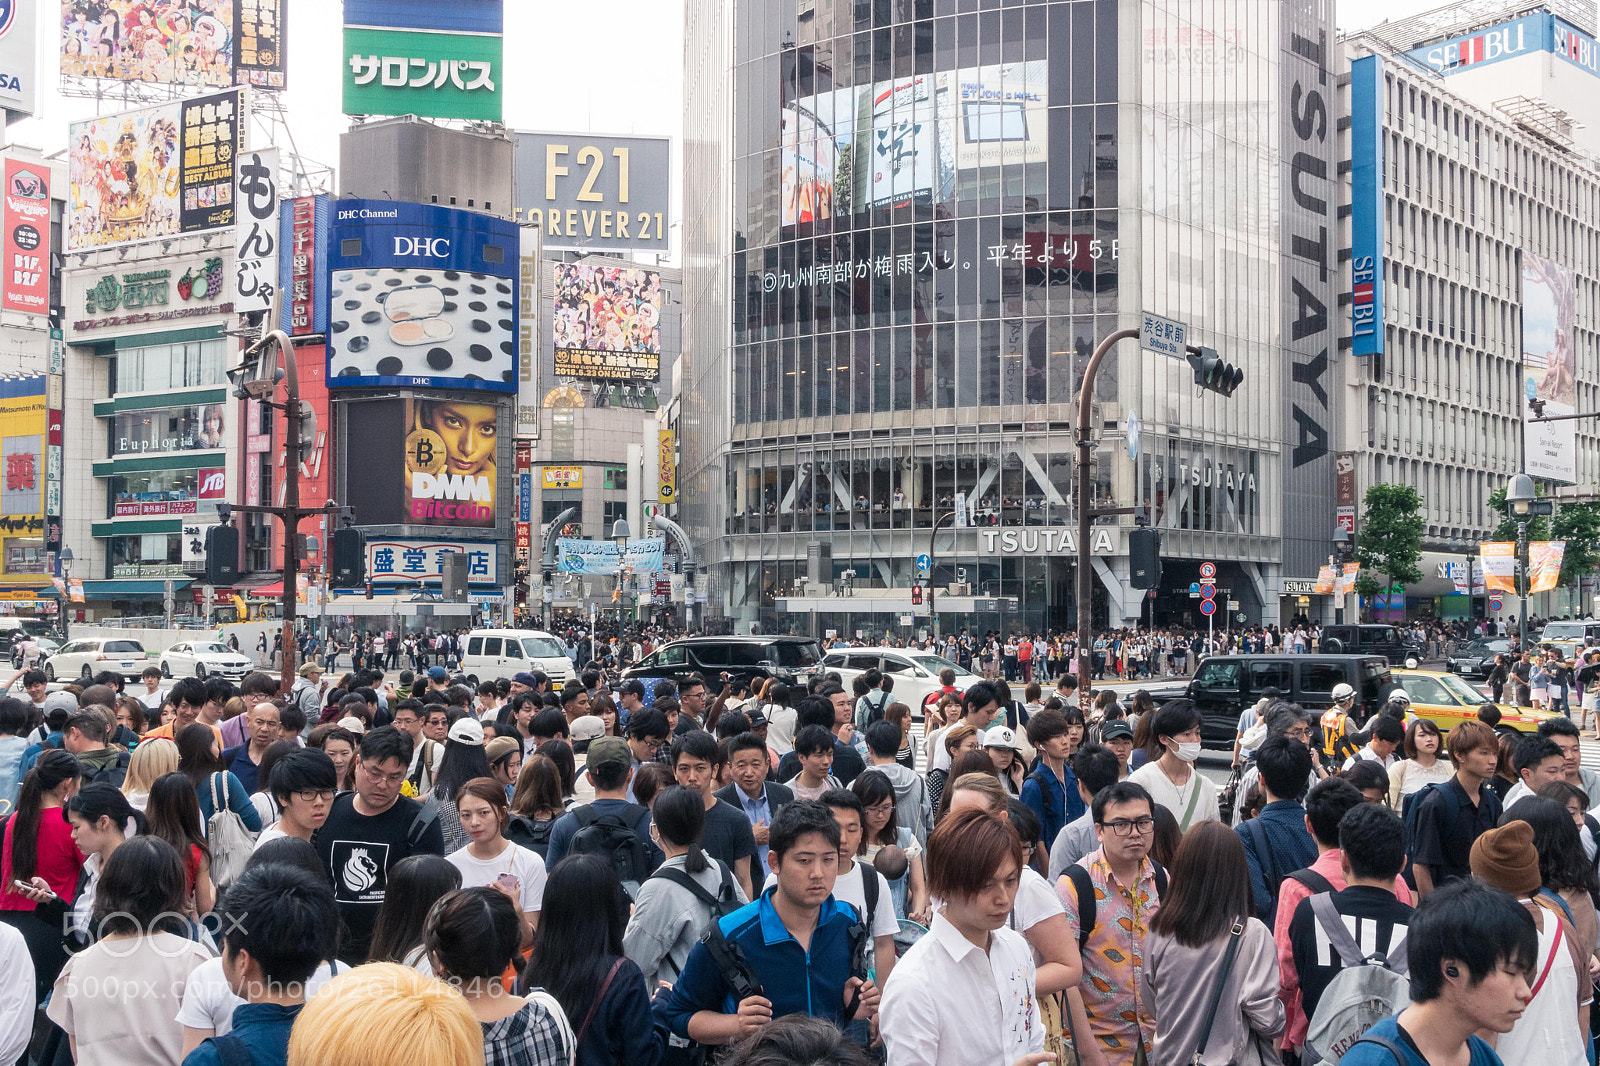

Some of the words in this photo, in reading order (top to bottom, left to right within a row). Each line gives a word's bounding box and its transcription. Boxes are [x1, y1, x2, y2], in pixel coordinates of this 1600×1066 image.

[1428, 24, 1526, 72] SEIBU
[1554, 24, 1597, 72] SEIBU
[350, 54, 495, 92] サロンパス
[185, 174, 202, 184] BEST
[204, 168, 232, 181] ALBUM
[546, 144, 629, 203] F21
[338, 210, 358, 220] DHC
[360, 209, 398, 219] Channel
[129, 224, 147, 239] ON
[238, 153, 276, 306] もんじゃ
[637, 212, 663, 240] 21
[393, 236, 450, 258] DHC
[1291, 28, 1328, 468] TSUTAYA
[14, 254, 40, 270] B1F
[14, 270, 41, 287] B2F
[520, 250, 536, 320] Taisei
[1353, 255, 1374, 338] SEIBU
[1144, 317, 1184, 344] 渋谷駅前
[519, 325, 532, 382] neon
[1150, 337, 1168, 350] Shibuya
[1169, 342, 1179, 353] Sta.
[412, 377, 430, 385] DHC
[555, 368, 597, 377] 2018.5.23
[598, 370, 610, 378] ON
[611, 370, 631, 379] SALE
[120, 433, 194, 454] Euphoria
[6, 452, 35, 491] 薬
[1180, 464, 1256, 493] TSUTAYA
[200, 472, 225, 495] JTB
[412, 471, 492, 502] DMM
[661, 486, 672, 495] 4F
[411, 500, 491, 521] Bitcoin
[1340, 516, 1353, 530] 本
[517, 525, 530, 547] 焼肉
[1284, 581, 1313, 592] TSUTAYA
